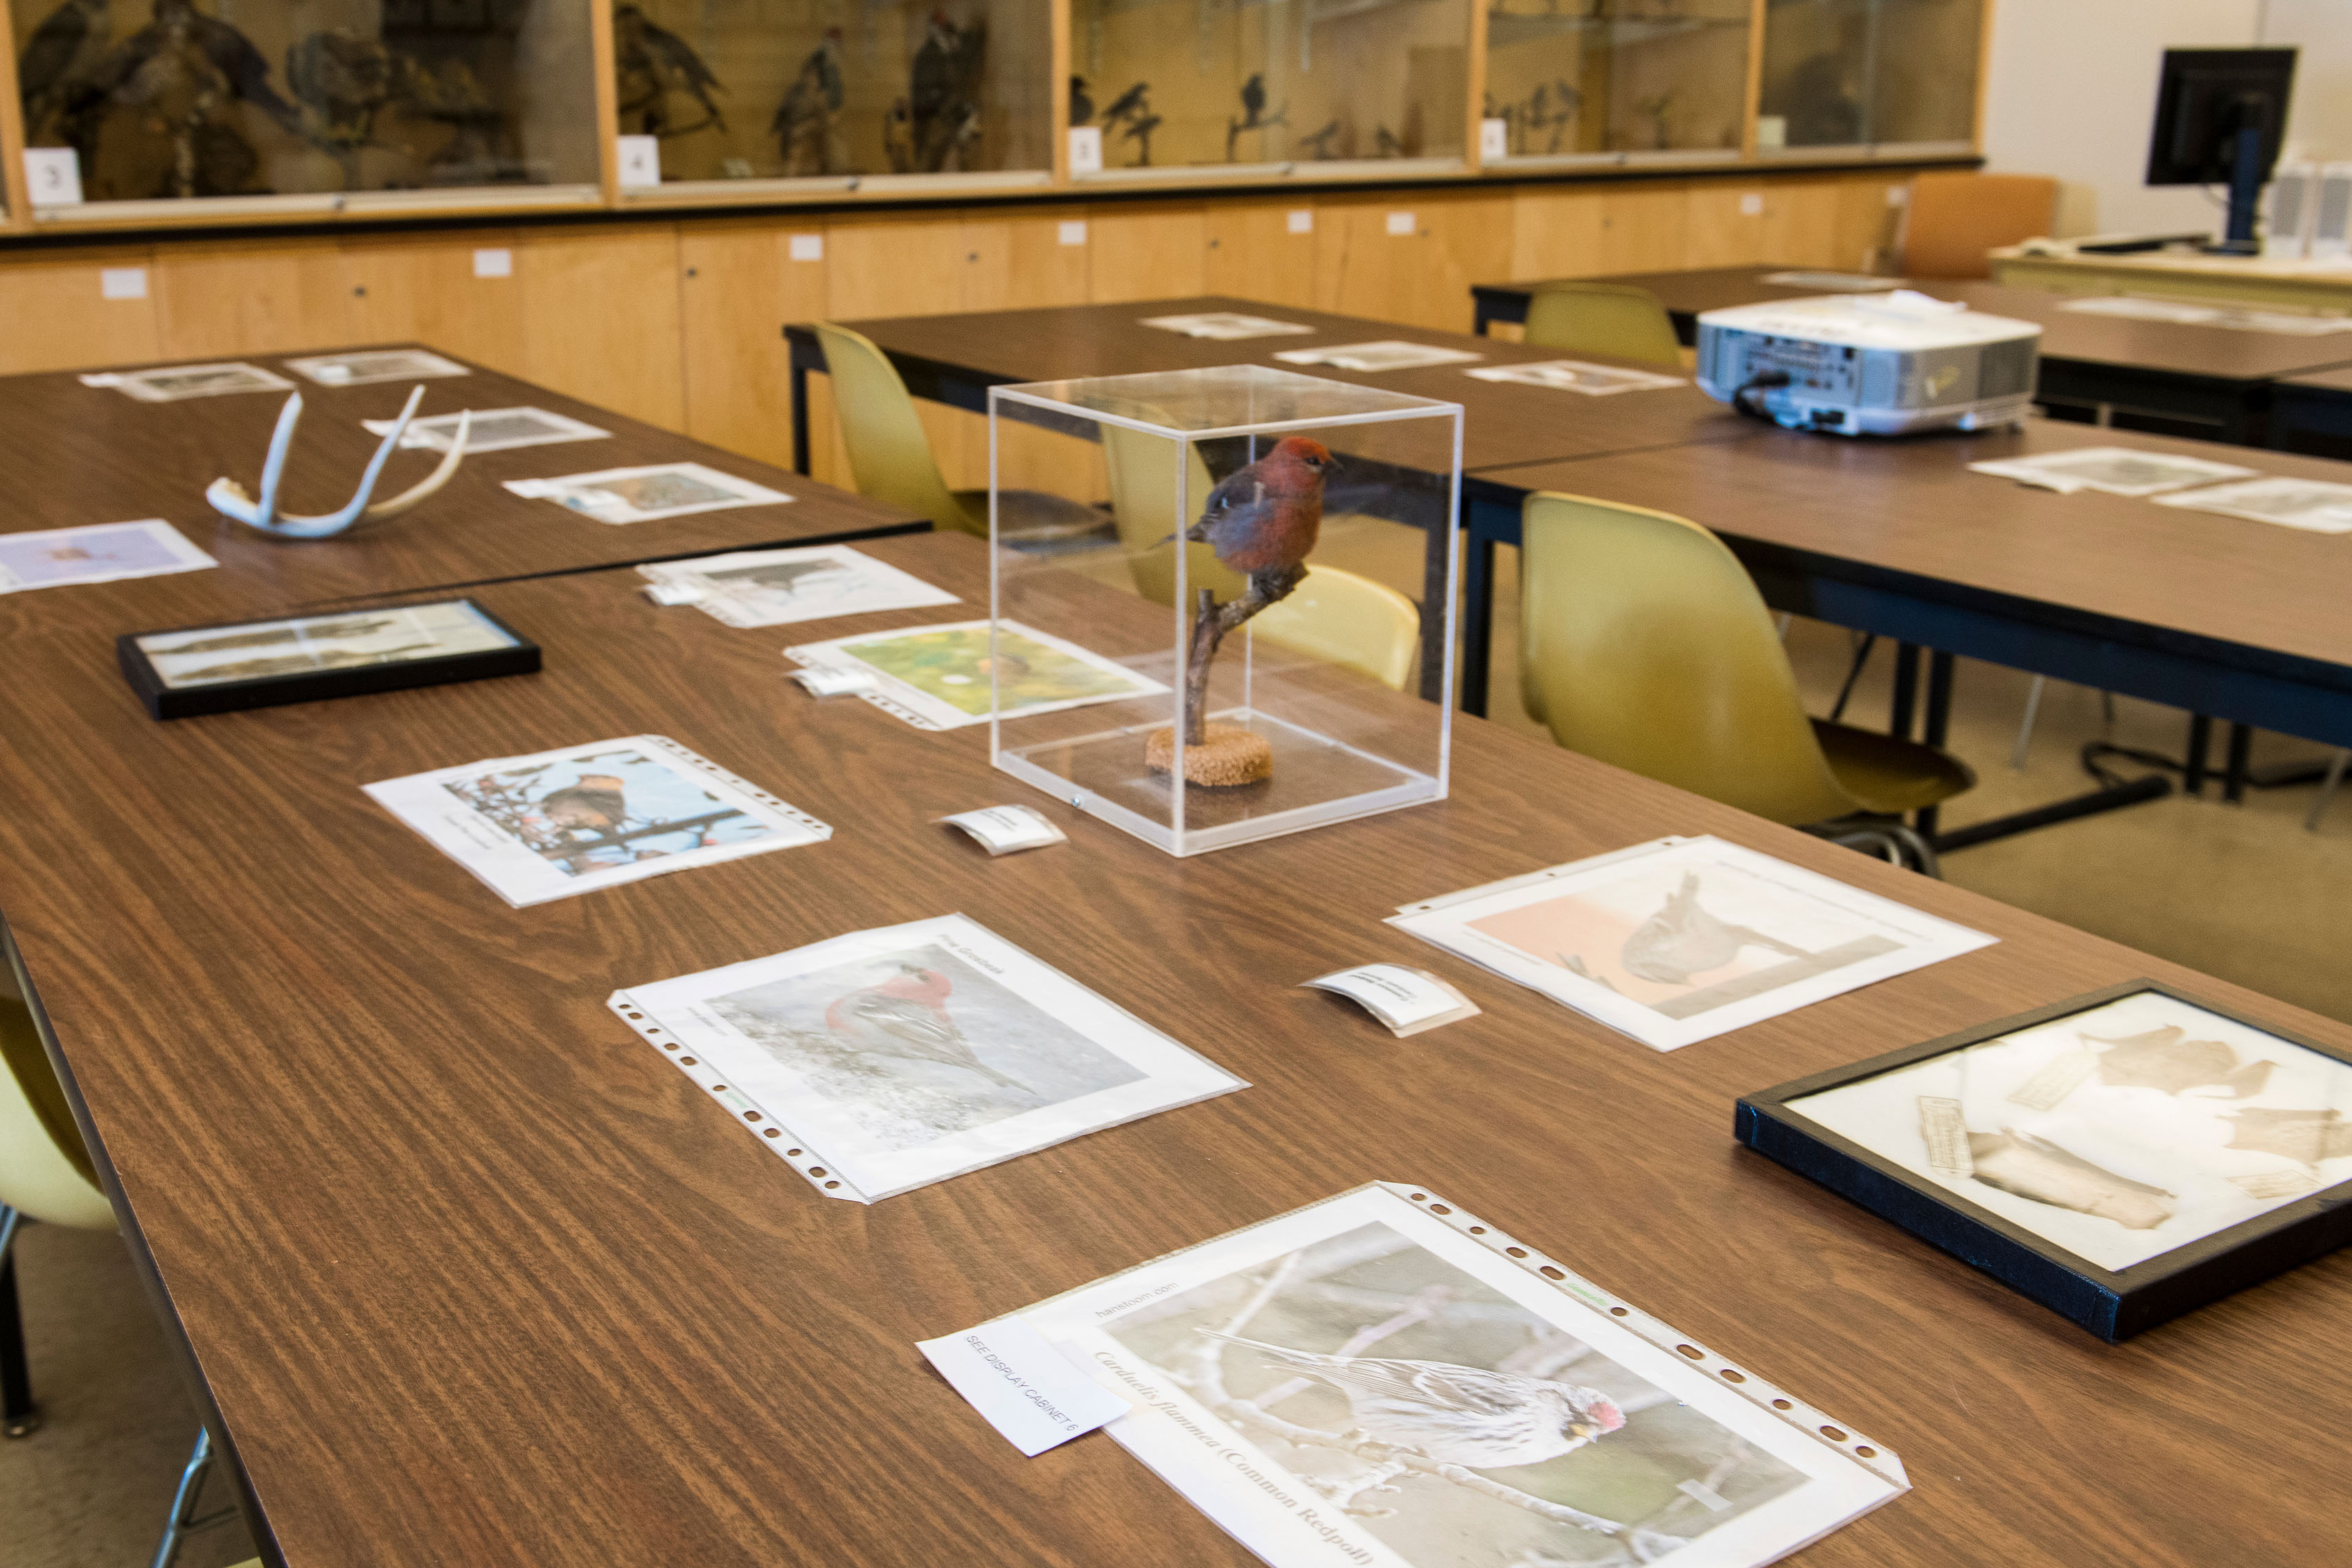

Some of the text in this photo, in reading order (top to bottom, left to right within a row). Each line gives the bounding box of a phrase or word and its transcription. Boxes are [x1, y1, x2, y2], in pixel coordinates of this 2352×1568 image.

[1095, 1282, 1180, 1318] hanstoom.com
[966, 1335, 991, 1355] SEE
[985, 1354, 1030, 1388] DISPLAY
[1024, 1389, 1072, 1424] CABINET
[1094, 1352, 1374, 1566] Carduelis flammea (Common Redpoll)
